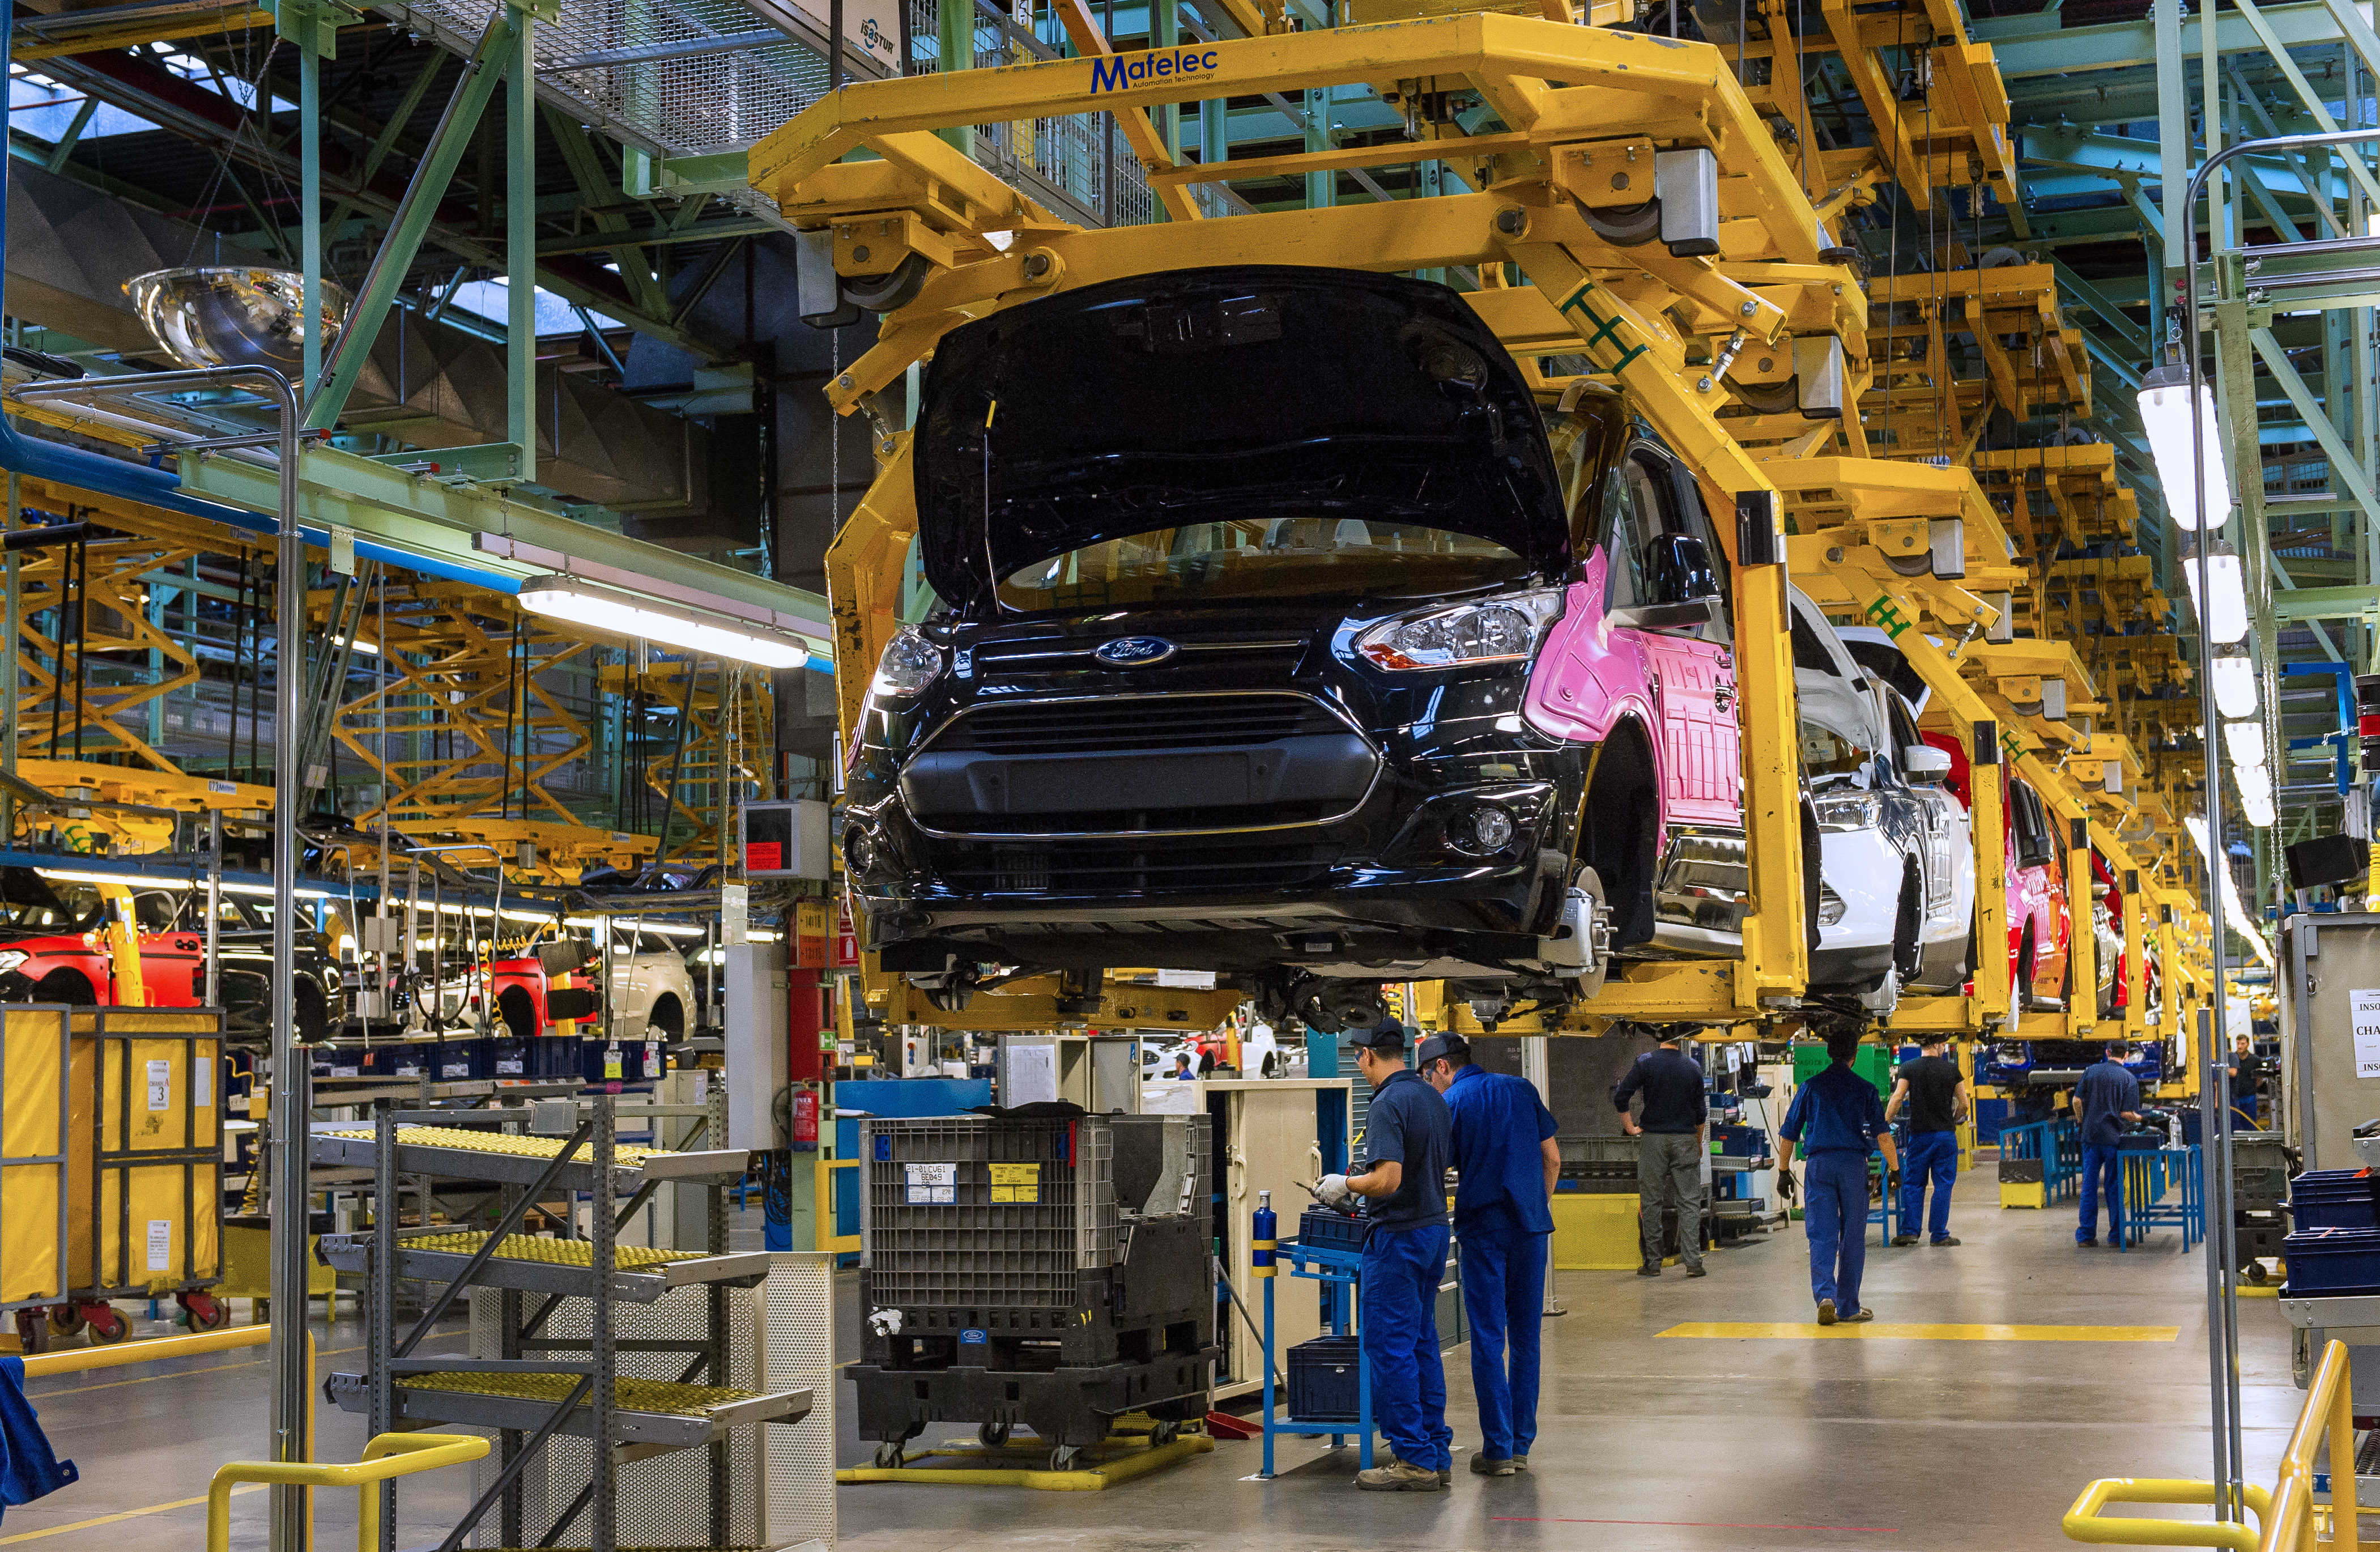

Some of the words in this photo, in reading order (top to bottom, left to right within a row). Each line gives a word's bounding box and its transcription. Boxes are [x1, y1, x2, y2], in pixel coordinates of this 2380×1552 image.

[1090, 50, 1218, 94] Mafelec
[1132, 78, 1173, 88] Automation
[1175, 72, 1215, 83] Technology
[1111, 640, 1155, 657] Ford
[2357, 1026, 2380, 1035] CHA
[158, 1087, 164, 1102] 3
